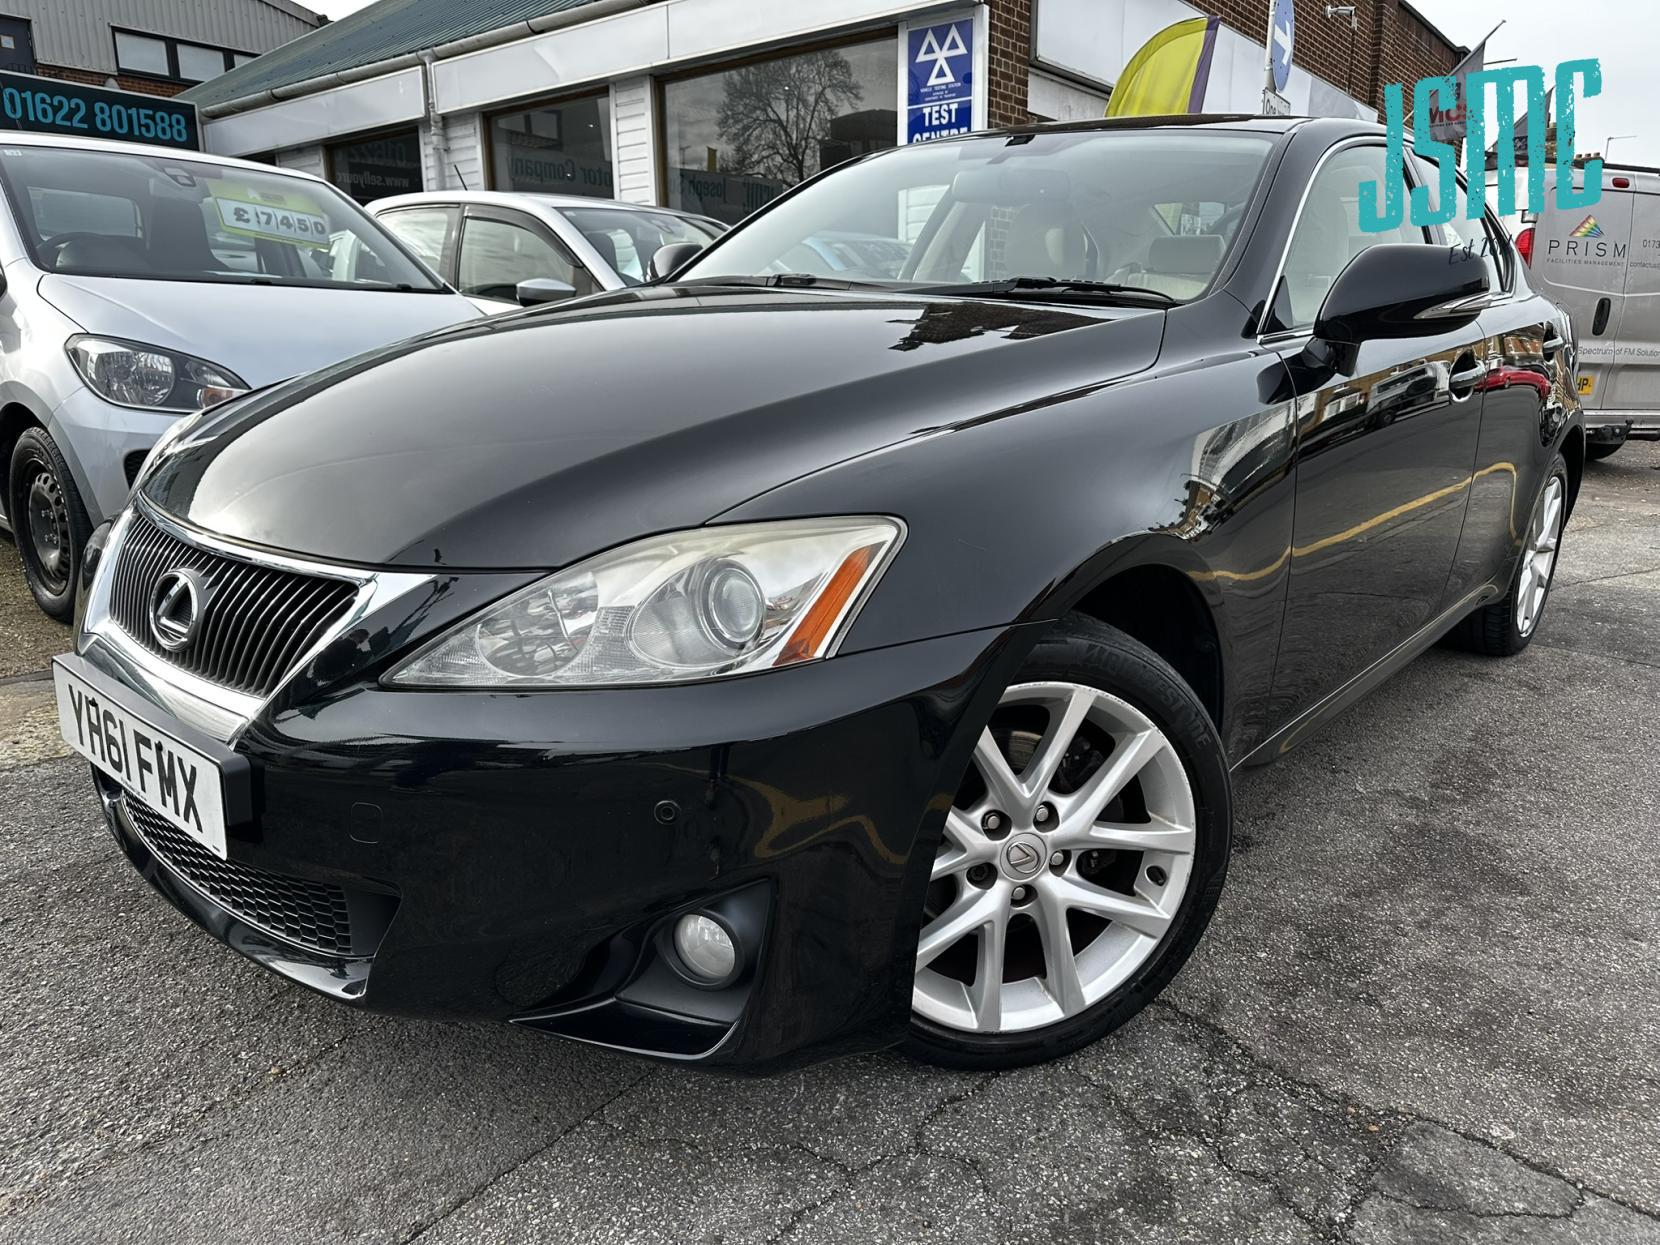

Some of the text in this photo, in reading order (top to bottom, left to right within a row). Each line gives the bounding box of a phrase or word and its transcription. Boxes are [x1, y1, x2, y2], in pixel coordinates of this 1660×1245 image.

[3, 87, 188, 142] 01622 801588
[923, 103, 959, 127] TEST
[1548, 240, 1626, 258] PRISM
[1584, 259, 1624, 267] MANAGEMENT
[1578, 346, 1613, 356] Spectrum
[1624, 348, 1634, 356] FM
[68, 684, 203, 833] YA61 FMX
